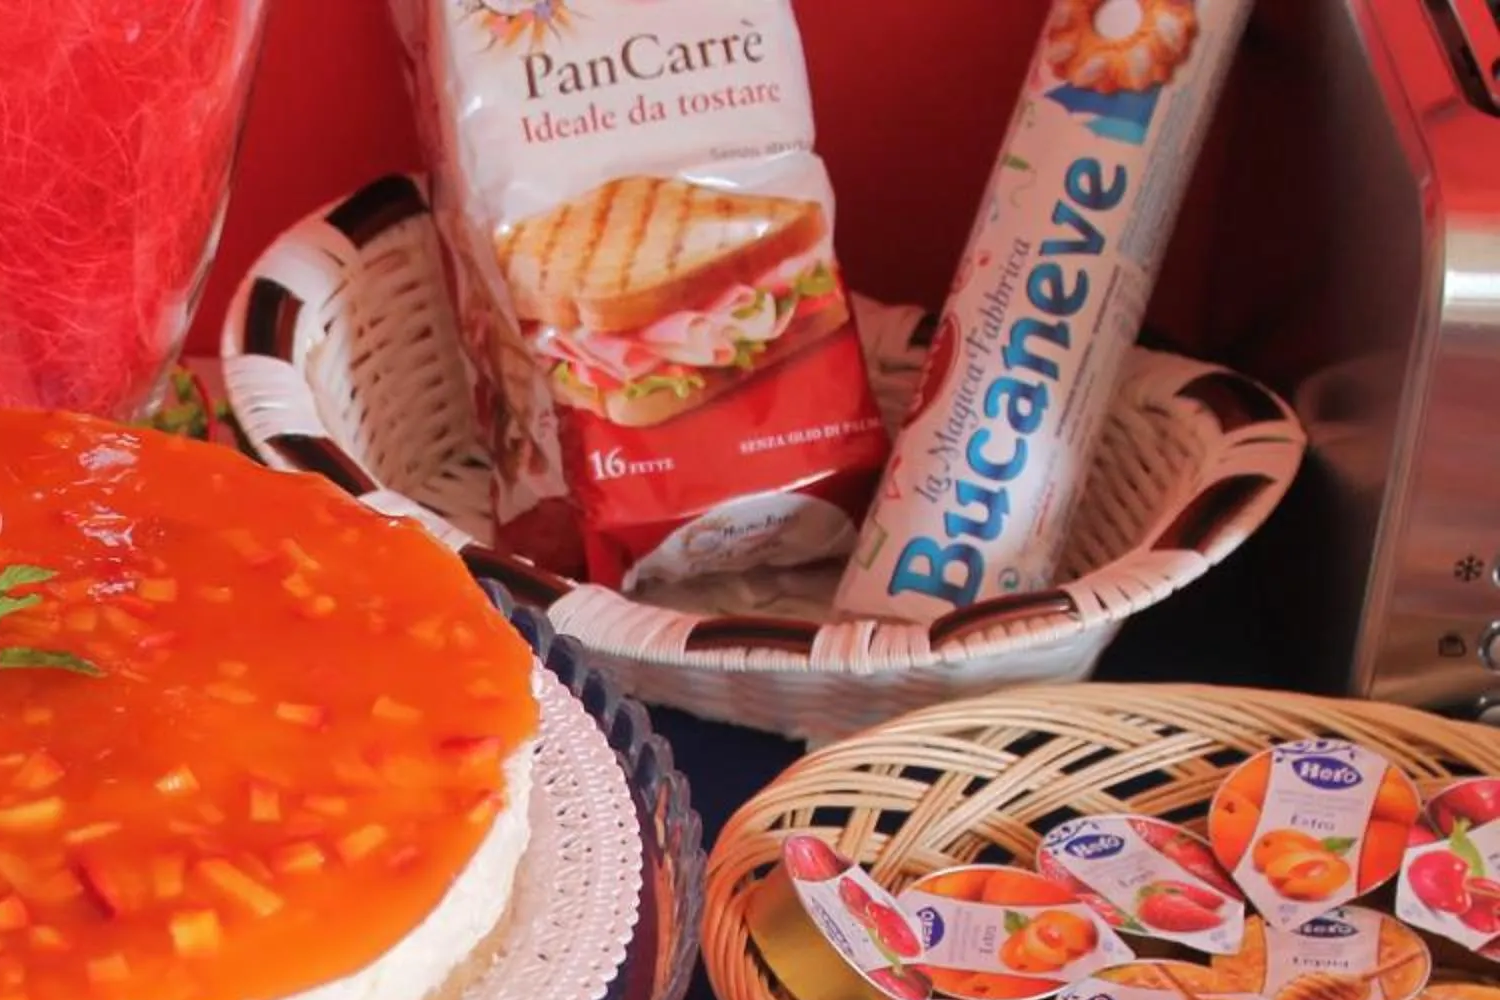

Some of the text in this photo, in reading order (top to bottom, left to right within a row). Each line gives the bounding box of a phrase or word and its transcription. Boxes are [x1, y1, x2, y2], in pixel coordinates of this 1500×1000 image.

[521, 19, 766, 100] PanCarrè
[521, 81, 782, 144] Ideale da tostare
[966, 238, 1032, 358] Fabbrica
[889, 156, 1128, 607] Bucaneve
[589, 446, 675, 481] 16 FETTE
[740, 417, 881, 454] SENZA OLIO DI PALM
[1300, 760, 1358, 785] Hero
